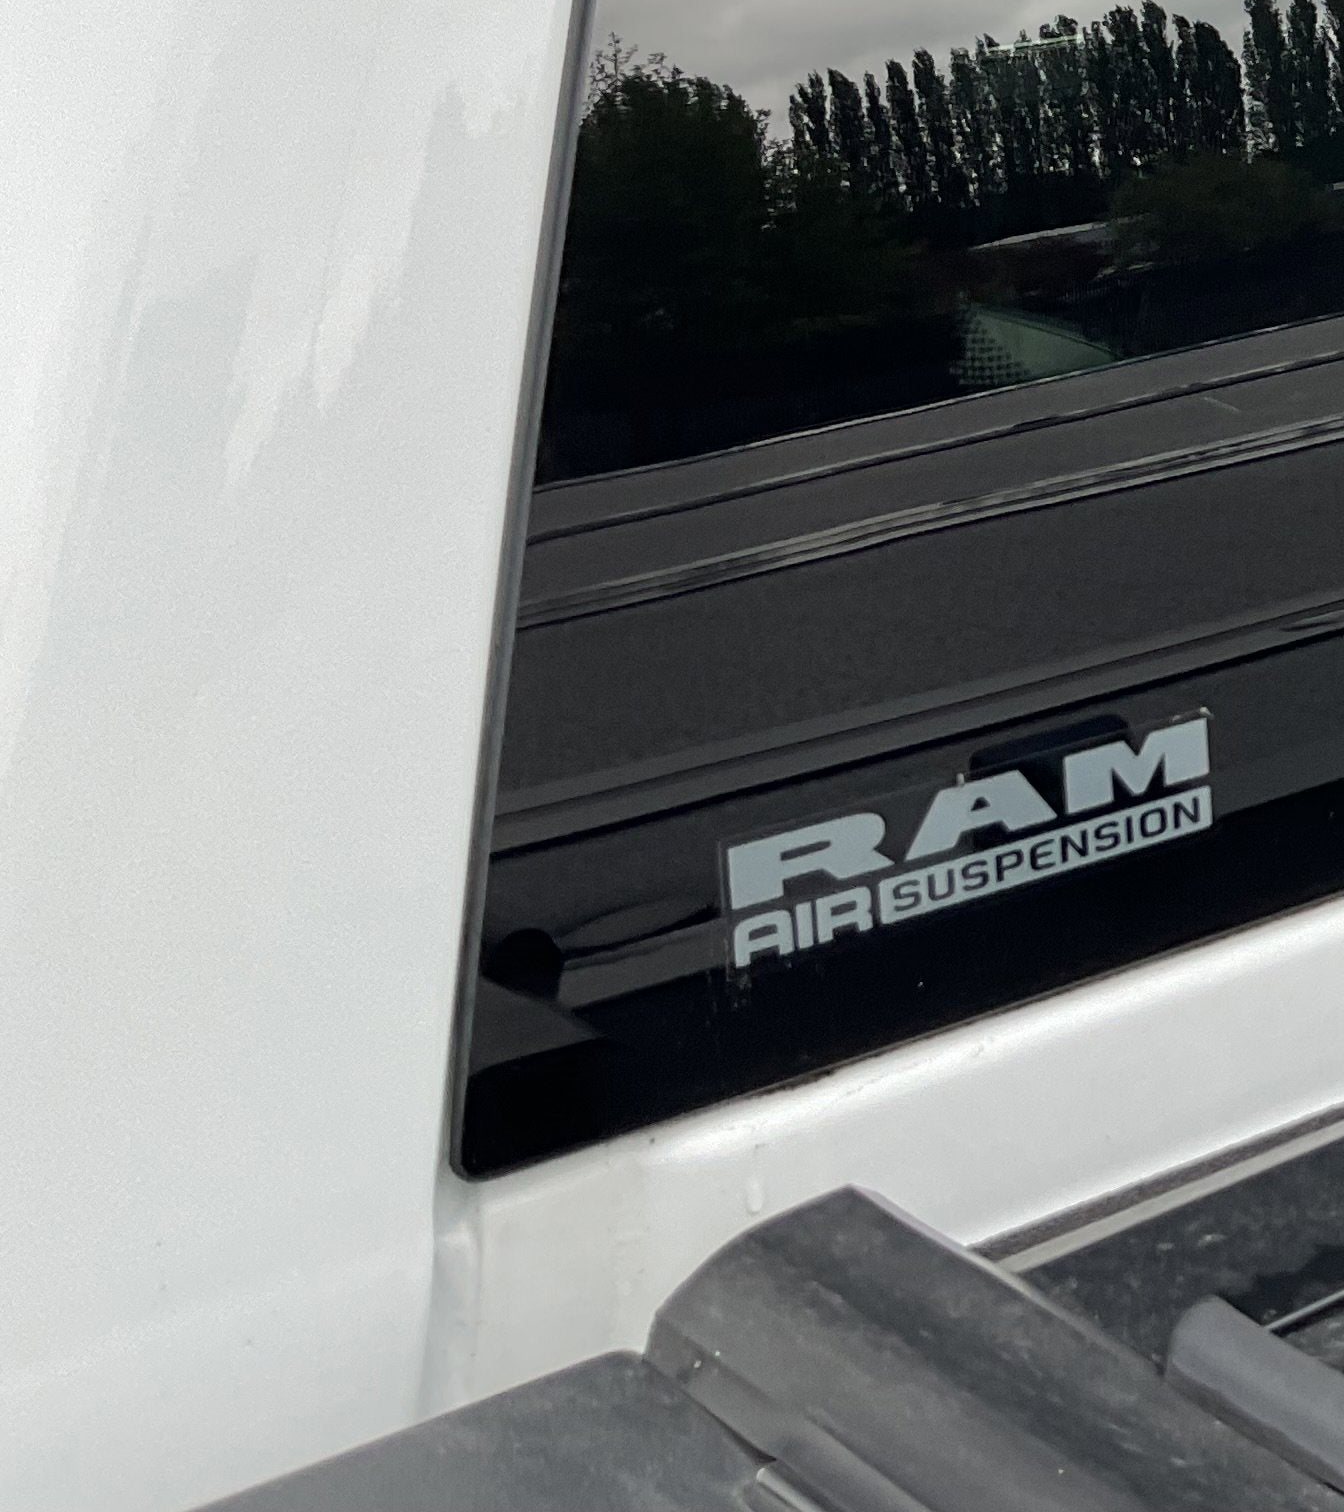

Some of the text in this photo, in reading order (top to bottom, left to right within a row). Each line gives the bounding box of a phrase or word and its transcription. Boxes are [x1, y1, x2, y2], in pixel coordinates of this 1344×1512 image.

[727, 717, 1211, 911] RAM
[733, 794, 1203, 968] AIR SUSPENSION
